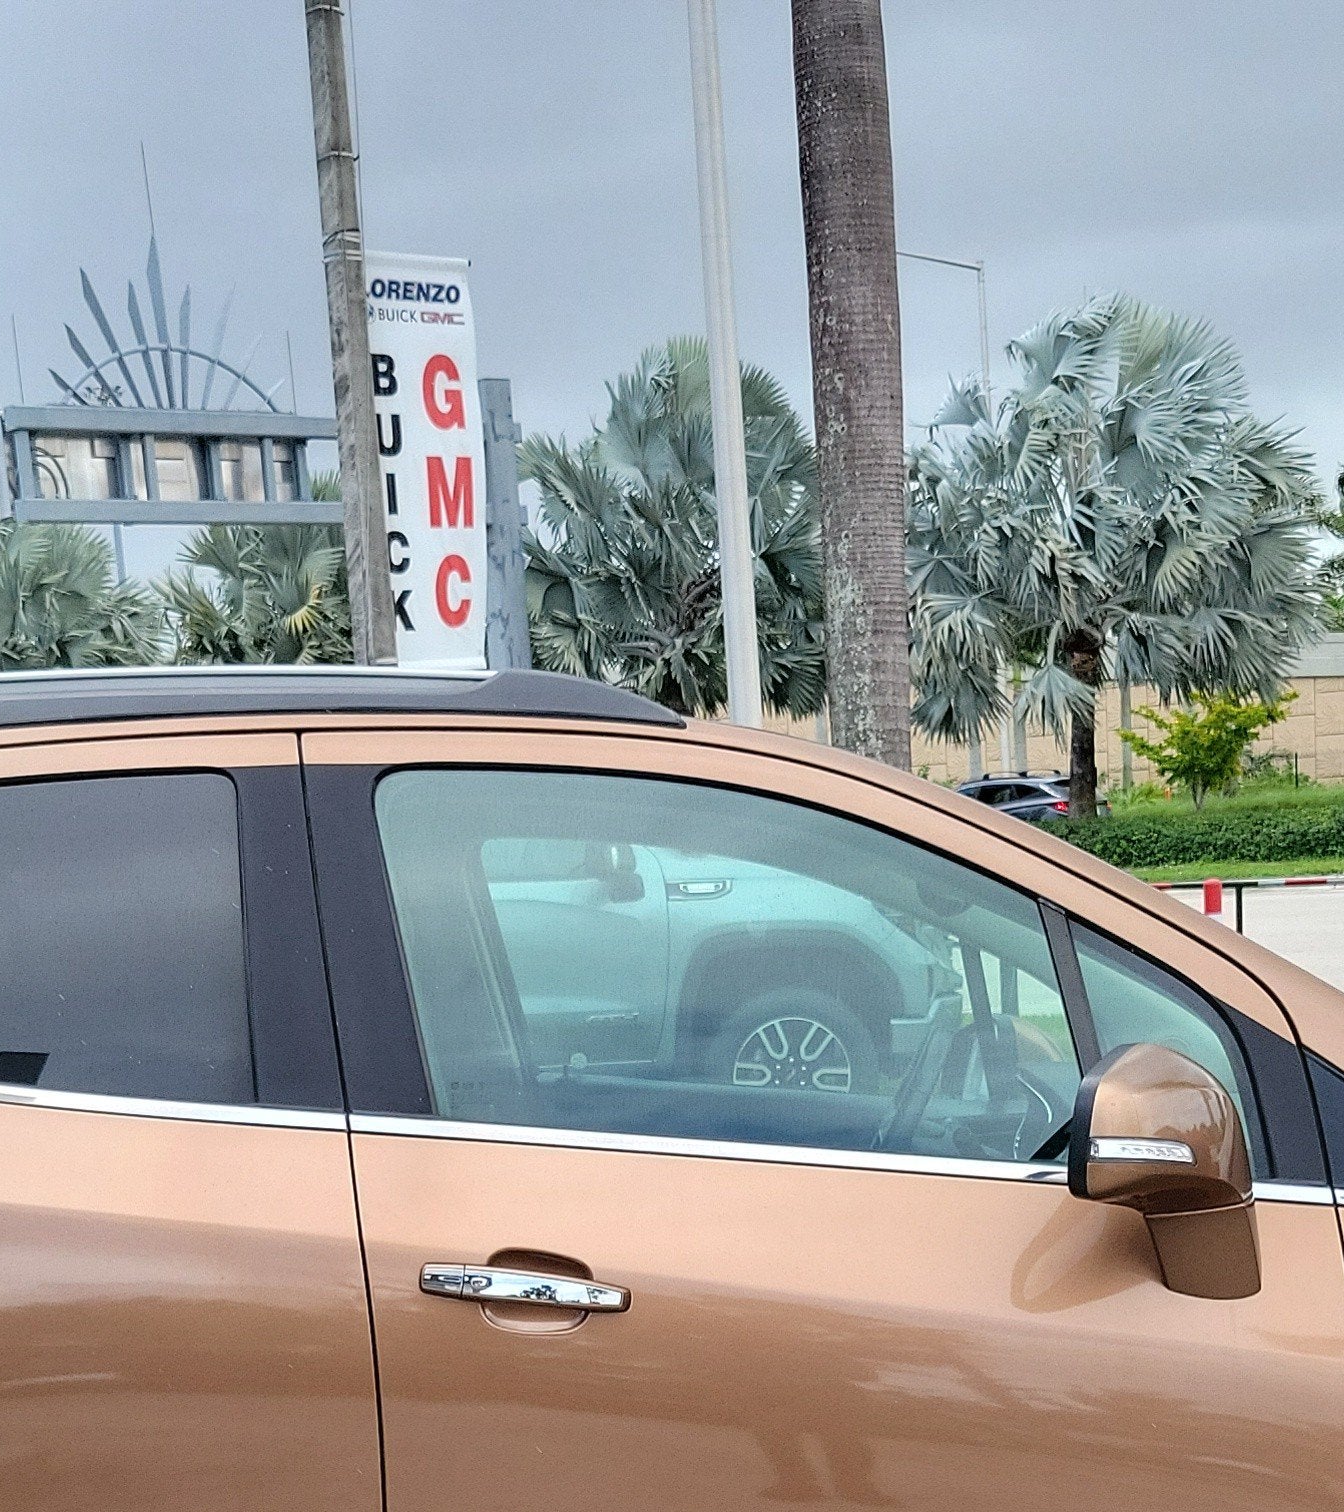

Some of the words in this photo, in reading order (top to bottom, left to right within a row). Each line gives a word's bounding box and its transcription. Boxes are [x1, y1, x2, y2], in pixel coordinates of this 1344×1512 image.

[367, 279, 461, 304] ORENZO
[378, 308, 417, 323] BUICK
[420, 310, 465, 325] GMC
[370, 353, 416, 632] BUICK
[422, 354, 475, 628] GMC
